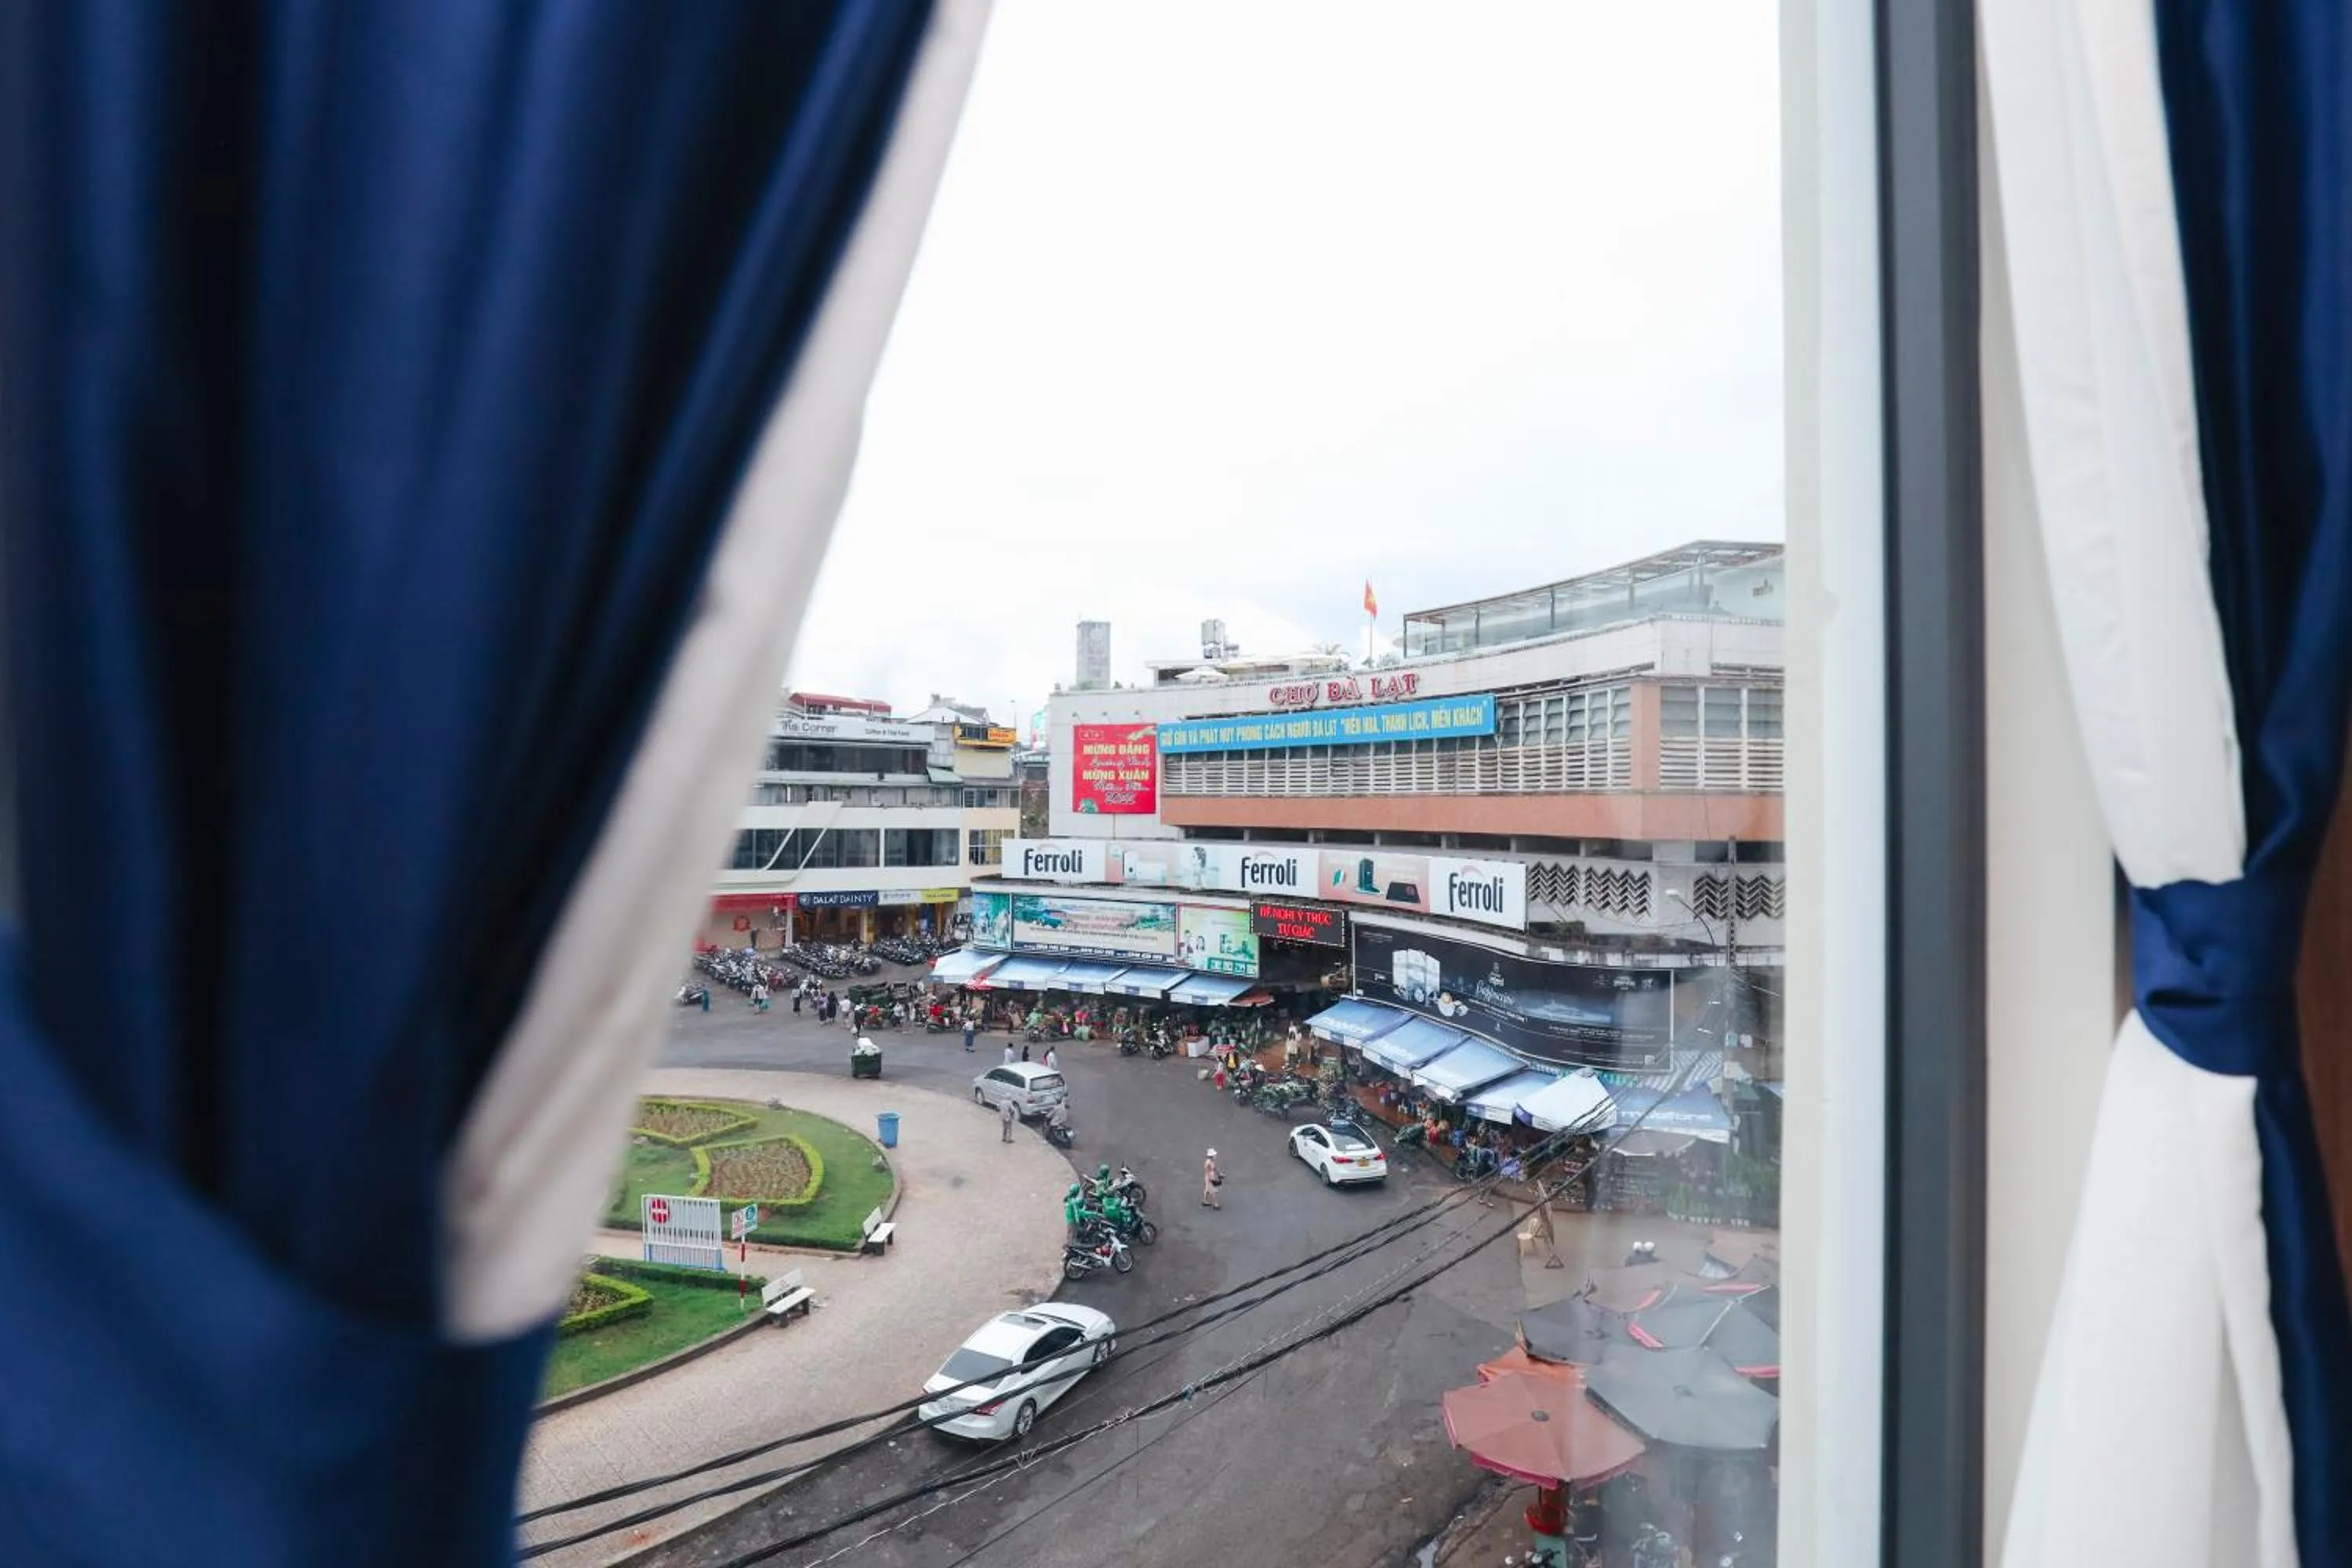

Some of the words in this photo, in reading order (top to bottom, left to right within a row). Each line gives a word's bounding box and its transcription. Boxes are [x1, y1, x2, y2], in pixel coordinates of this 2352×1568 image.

[1269, 681, 1319, 708] CHỢ
[1327, 673, 1362, 702] ĐÀ
[1370, 673, 1418, 700] LẠT
[802, 721, 837, 734] Corner
[1083, 742, 1116, 755] MỪNG
[1119, 740, 1150, 755] ĐẢNG
[1083, 768, 1116, 781] MỪNG
[1118, 768, 1150, 781] XUÂN
[1024, 848, 1083, 876] Ferroli
[1240, 855, 1298, 887] Ferroli
[1448, 872, 1504, 913] Ferroli
